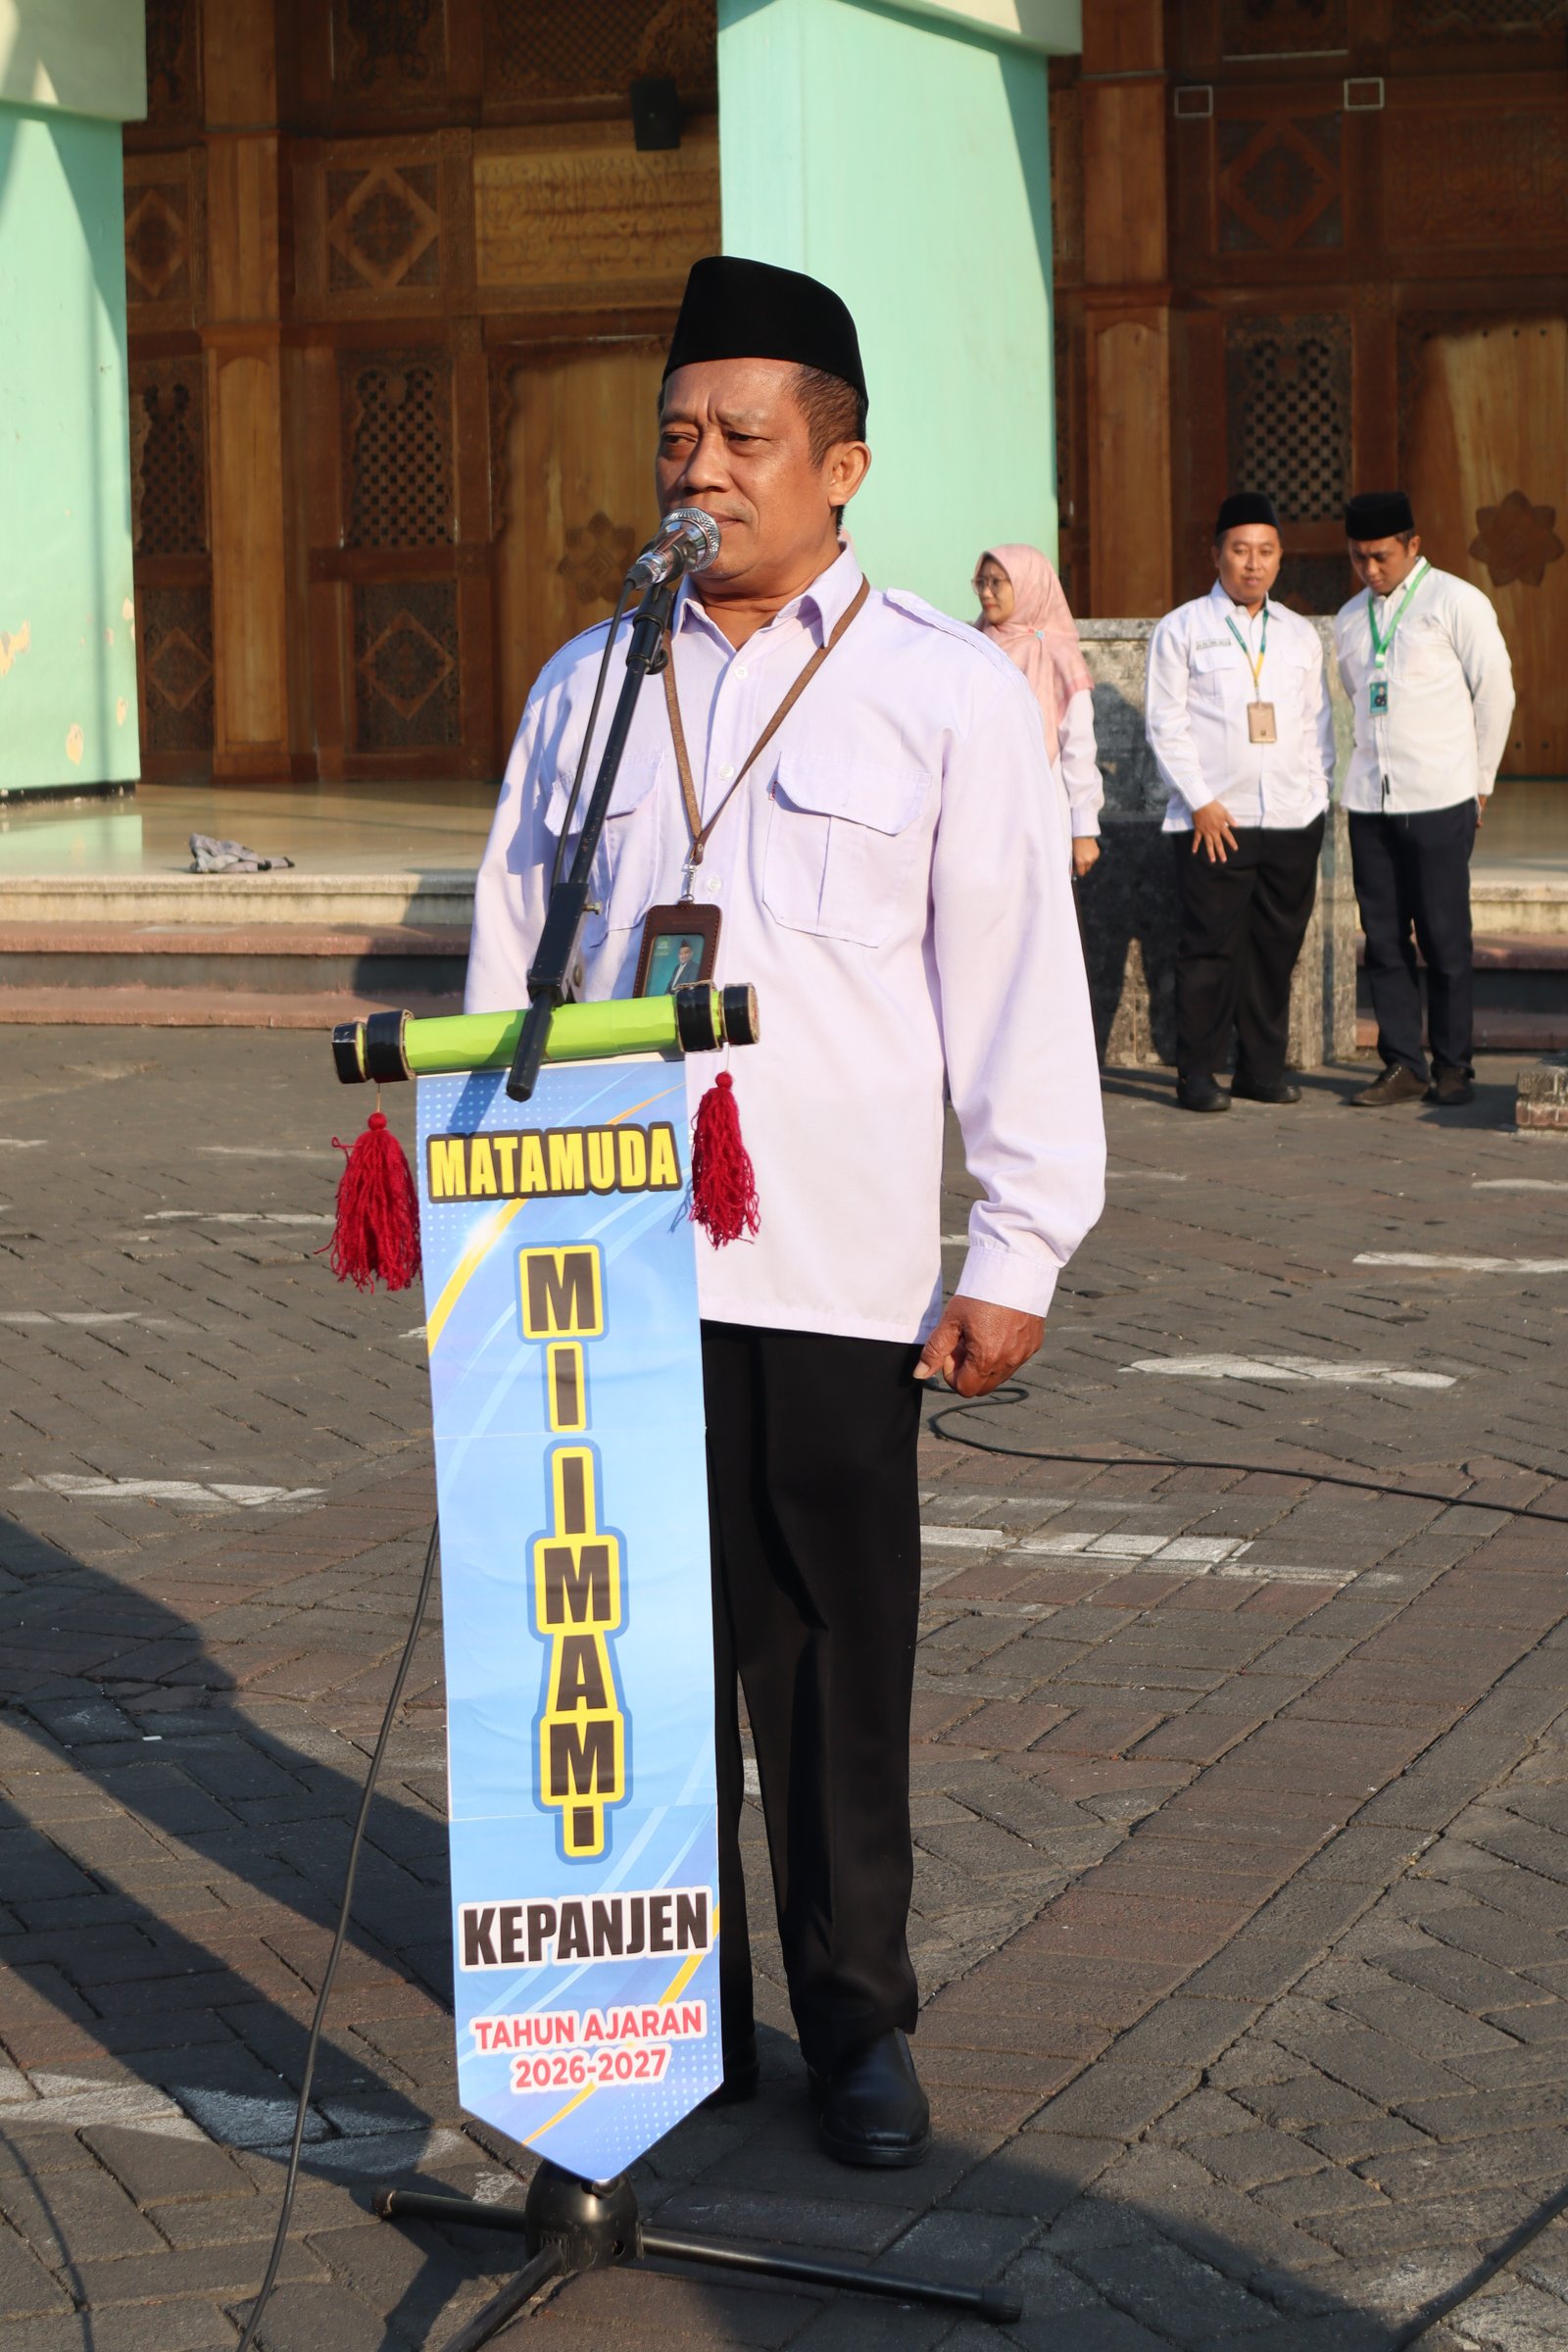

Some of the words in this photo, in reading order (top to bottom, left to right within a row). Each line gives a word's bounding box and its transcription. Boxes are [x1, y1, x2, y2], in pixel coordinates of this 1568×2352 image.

[429, 1127, 679, 1198] MATAMUDA
[464, 1892, 708, 1966] KEPANJEN
[475, 2015, 574, 2050] TAHUN
[584, 2005, 702, 2042] AJARAN
[515, 2048, 666, 2088] 2026-2027
